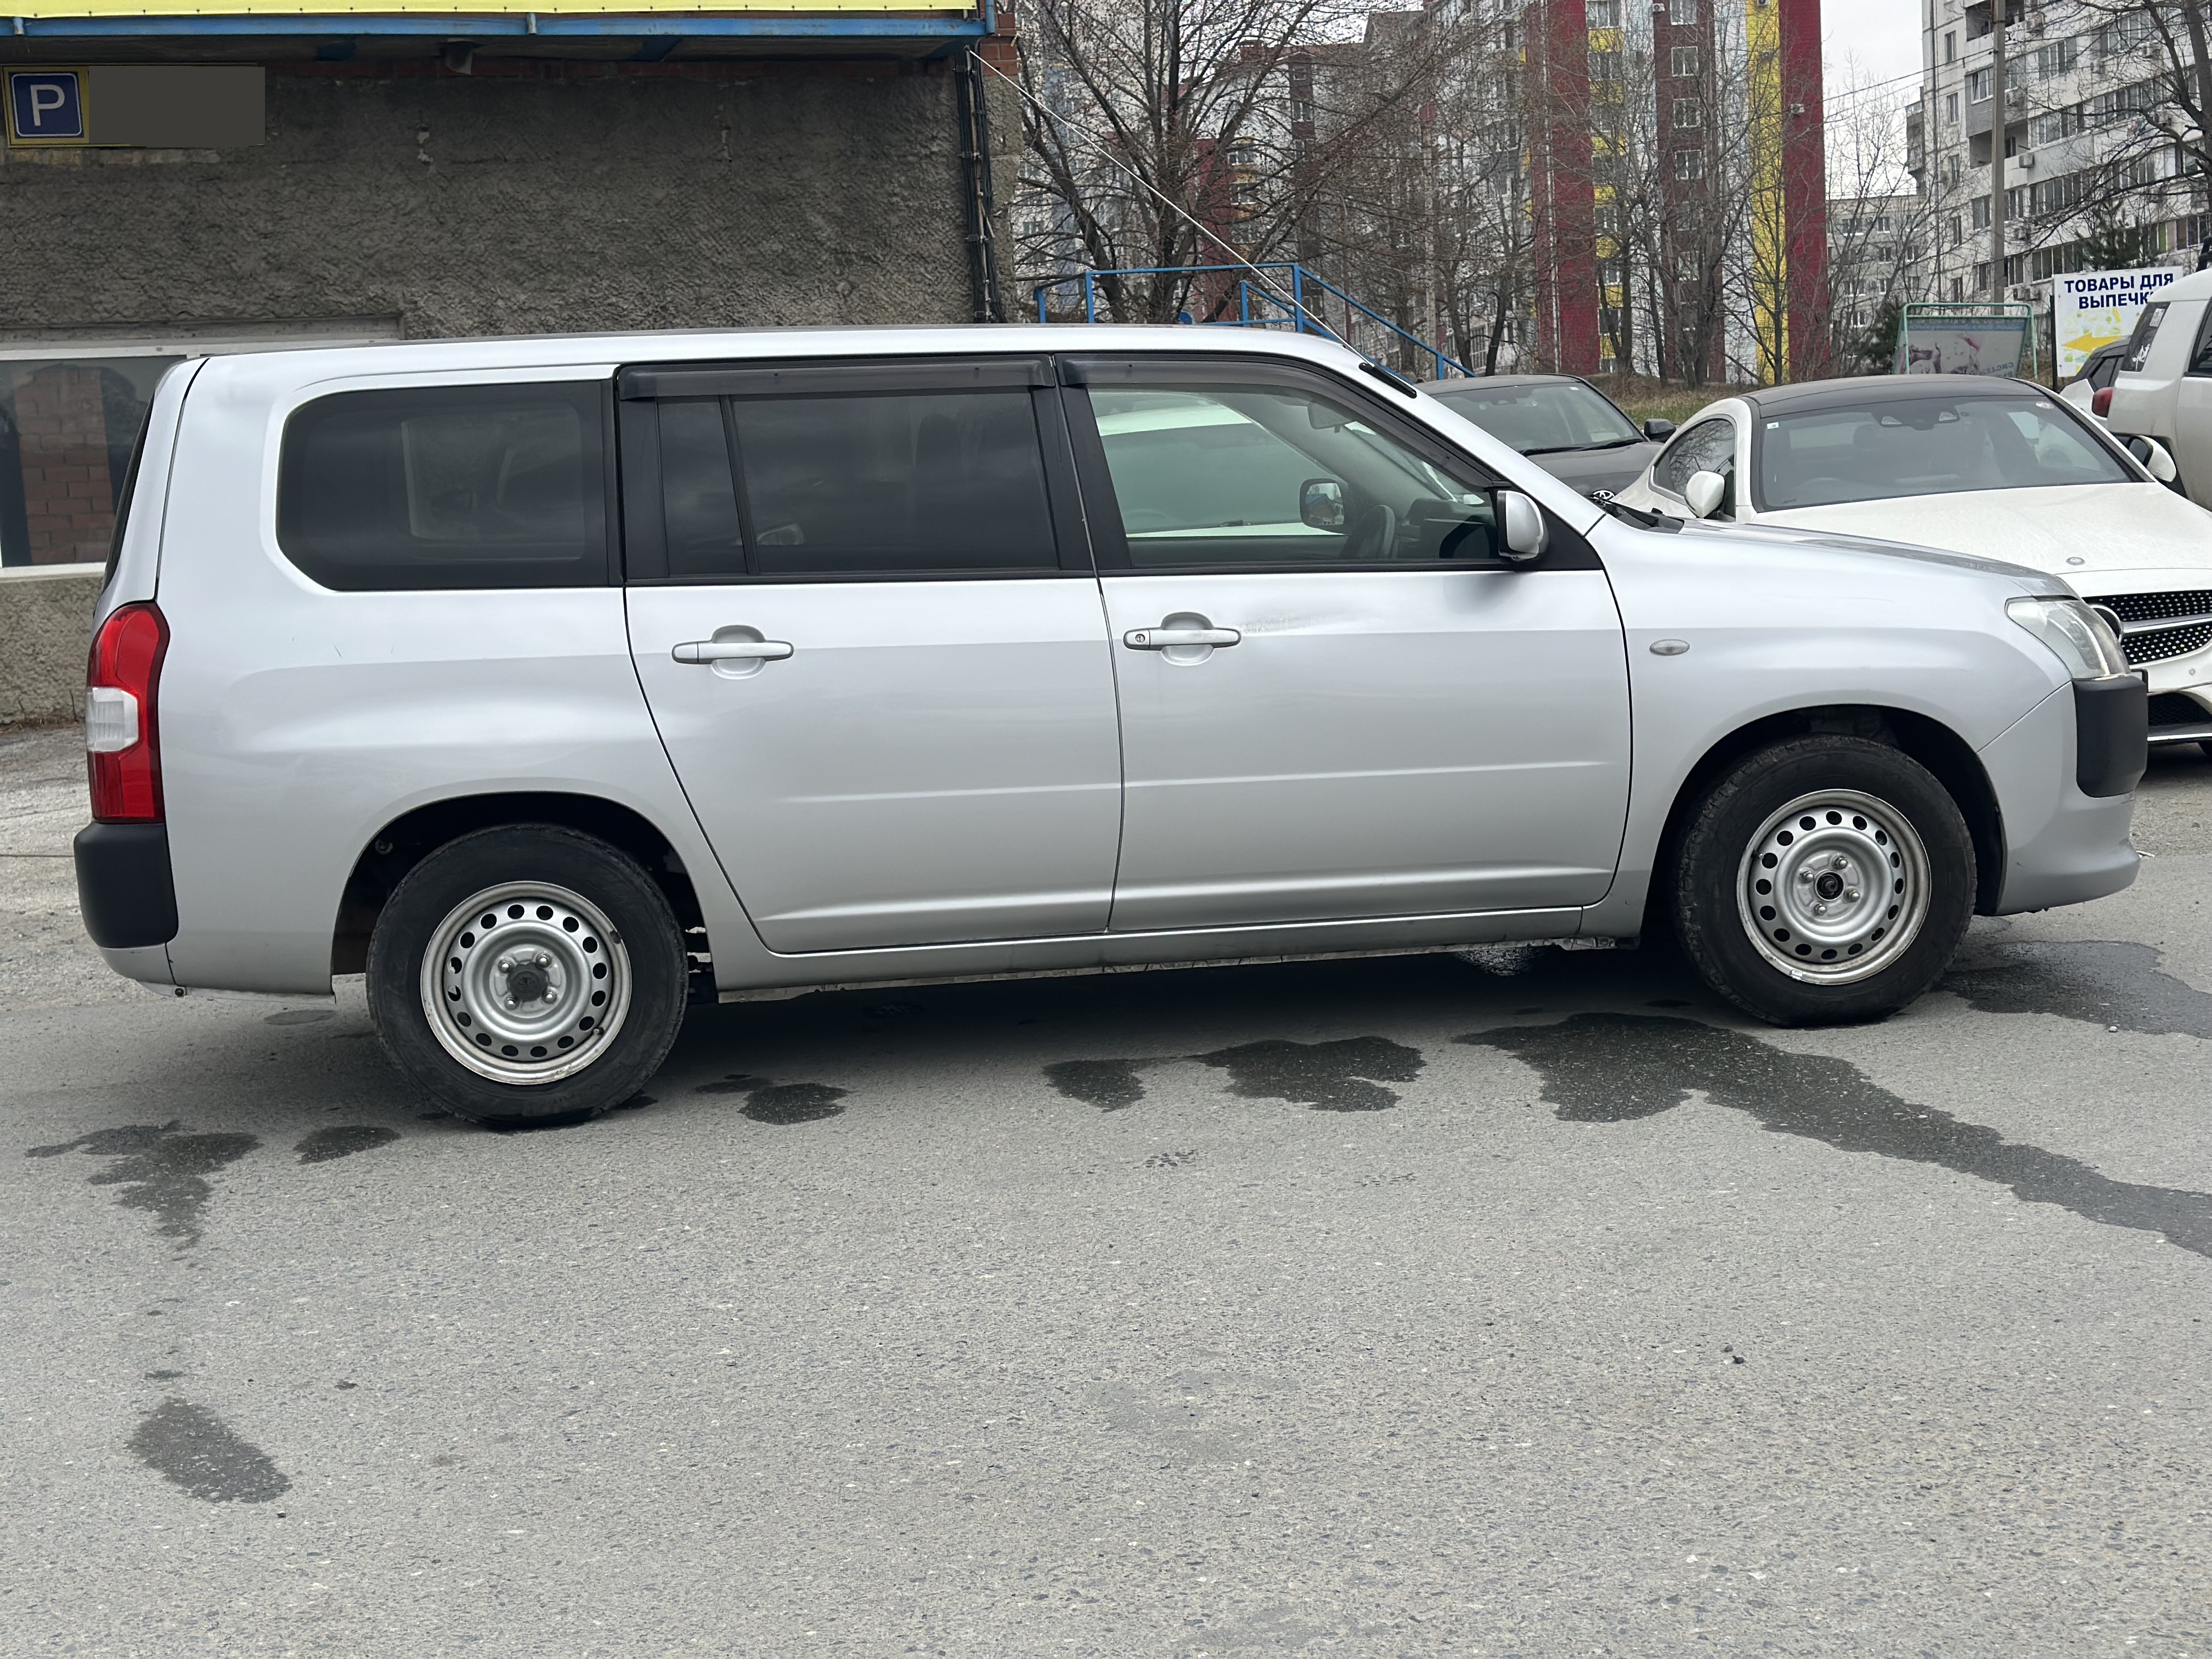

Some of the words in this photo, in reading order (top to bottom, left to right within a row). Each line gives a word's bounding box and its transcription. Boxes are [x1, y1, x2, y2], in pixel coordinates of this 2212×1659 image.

[30, 84, 65, 127] P
[2064, 275, 2135, 294] ТОВАРЫ
[2140, 273, 2174, 291] ДЛЯ
[2078, 291, 2153, 309] ВЫПЕЧК
